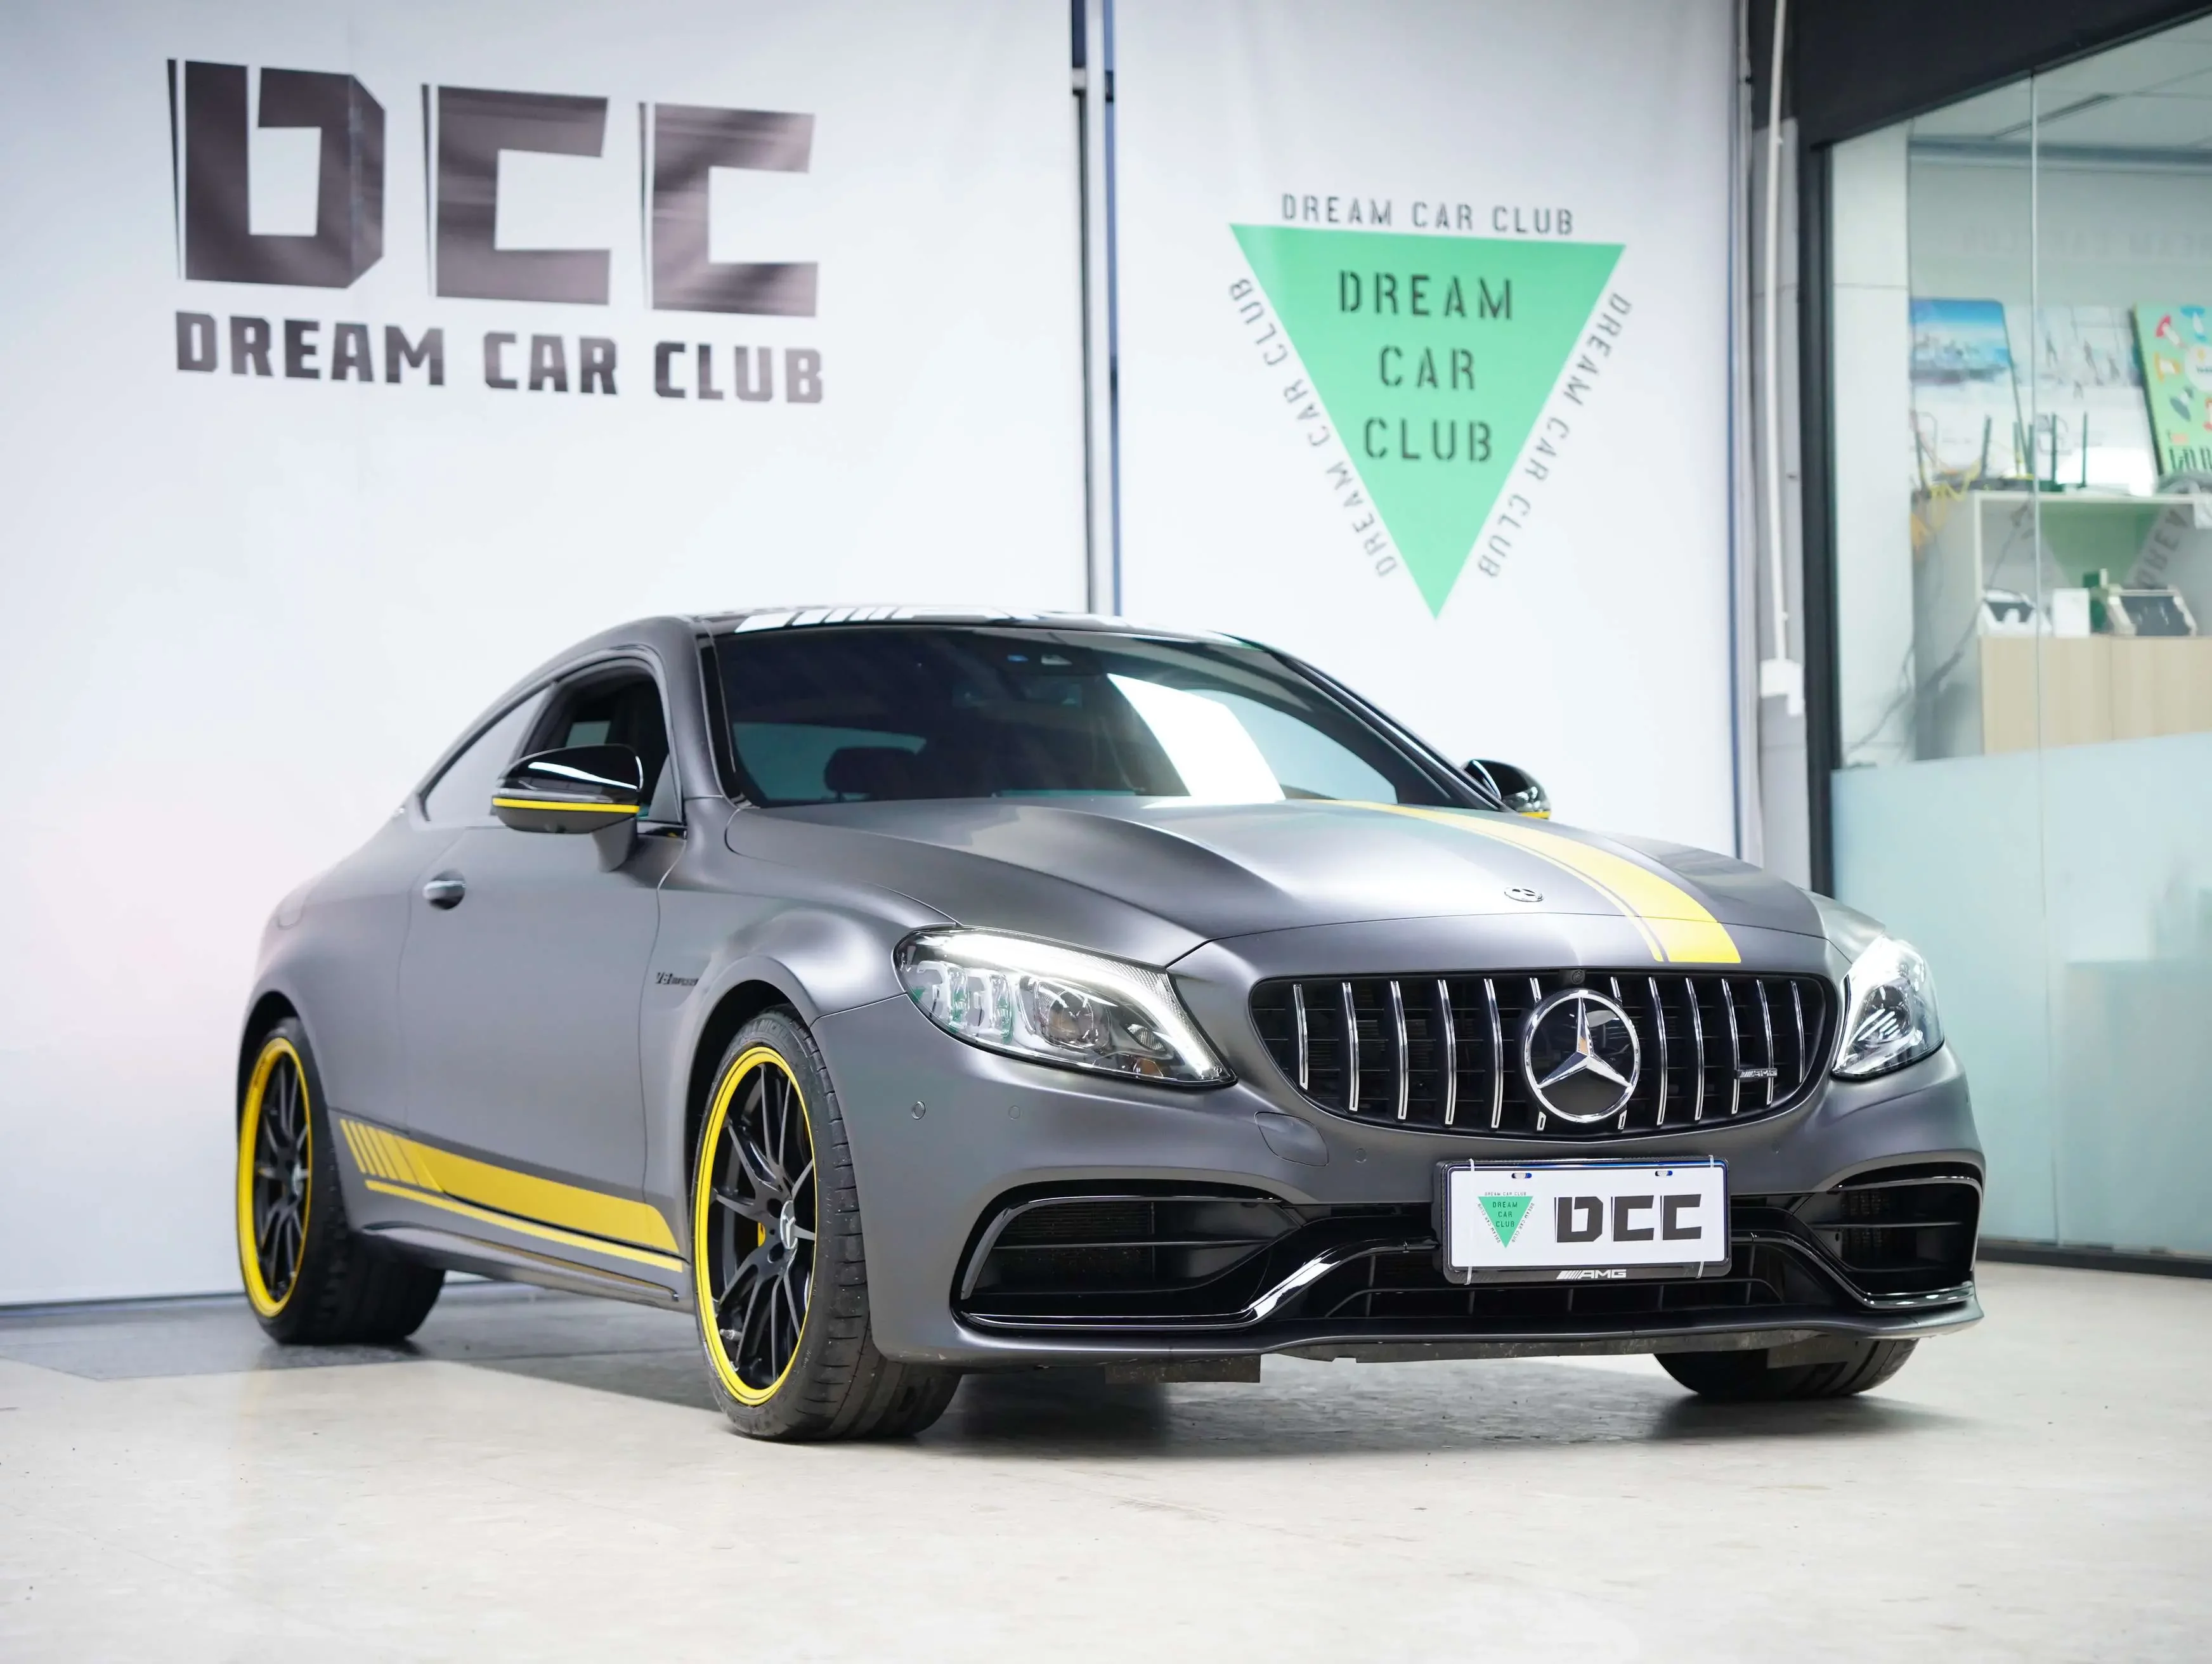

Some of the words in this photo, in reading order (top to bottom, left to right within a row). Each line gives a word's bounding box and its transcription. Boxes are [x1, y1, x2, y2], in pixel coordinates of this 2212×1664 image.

[167, 58, 817, 317] DCC
[1282, 193, 1393, 227] DREAM
[1412, 201, 1473, 230] CAR
[1492, 205, 1573, 235] CLUB
[1229, 278, 1289, 366] CLUB
[1339, 270, 1513, 320] DREAM
[175, 310, 445, 386] DREAM
[483, 330, 618, 396] CAR
[654, 340, 823, 404] CLUB
[1379, 345, 1476, 391] CAR
[1562, 292, 1632, 406] DREAM
[1283, 378, 1330, 446] CAR
[1363, 417, 1492, 463] CLUB
[1525, 417, 1570, 481] CAR
[1325, 460, 1398, 577] DREAM
[1477, 493, 1532, 577] CLUB
[1554, 1193, 1702, 1244] DCC
[1577, 1269, 1627, 1279] AMG
